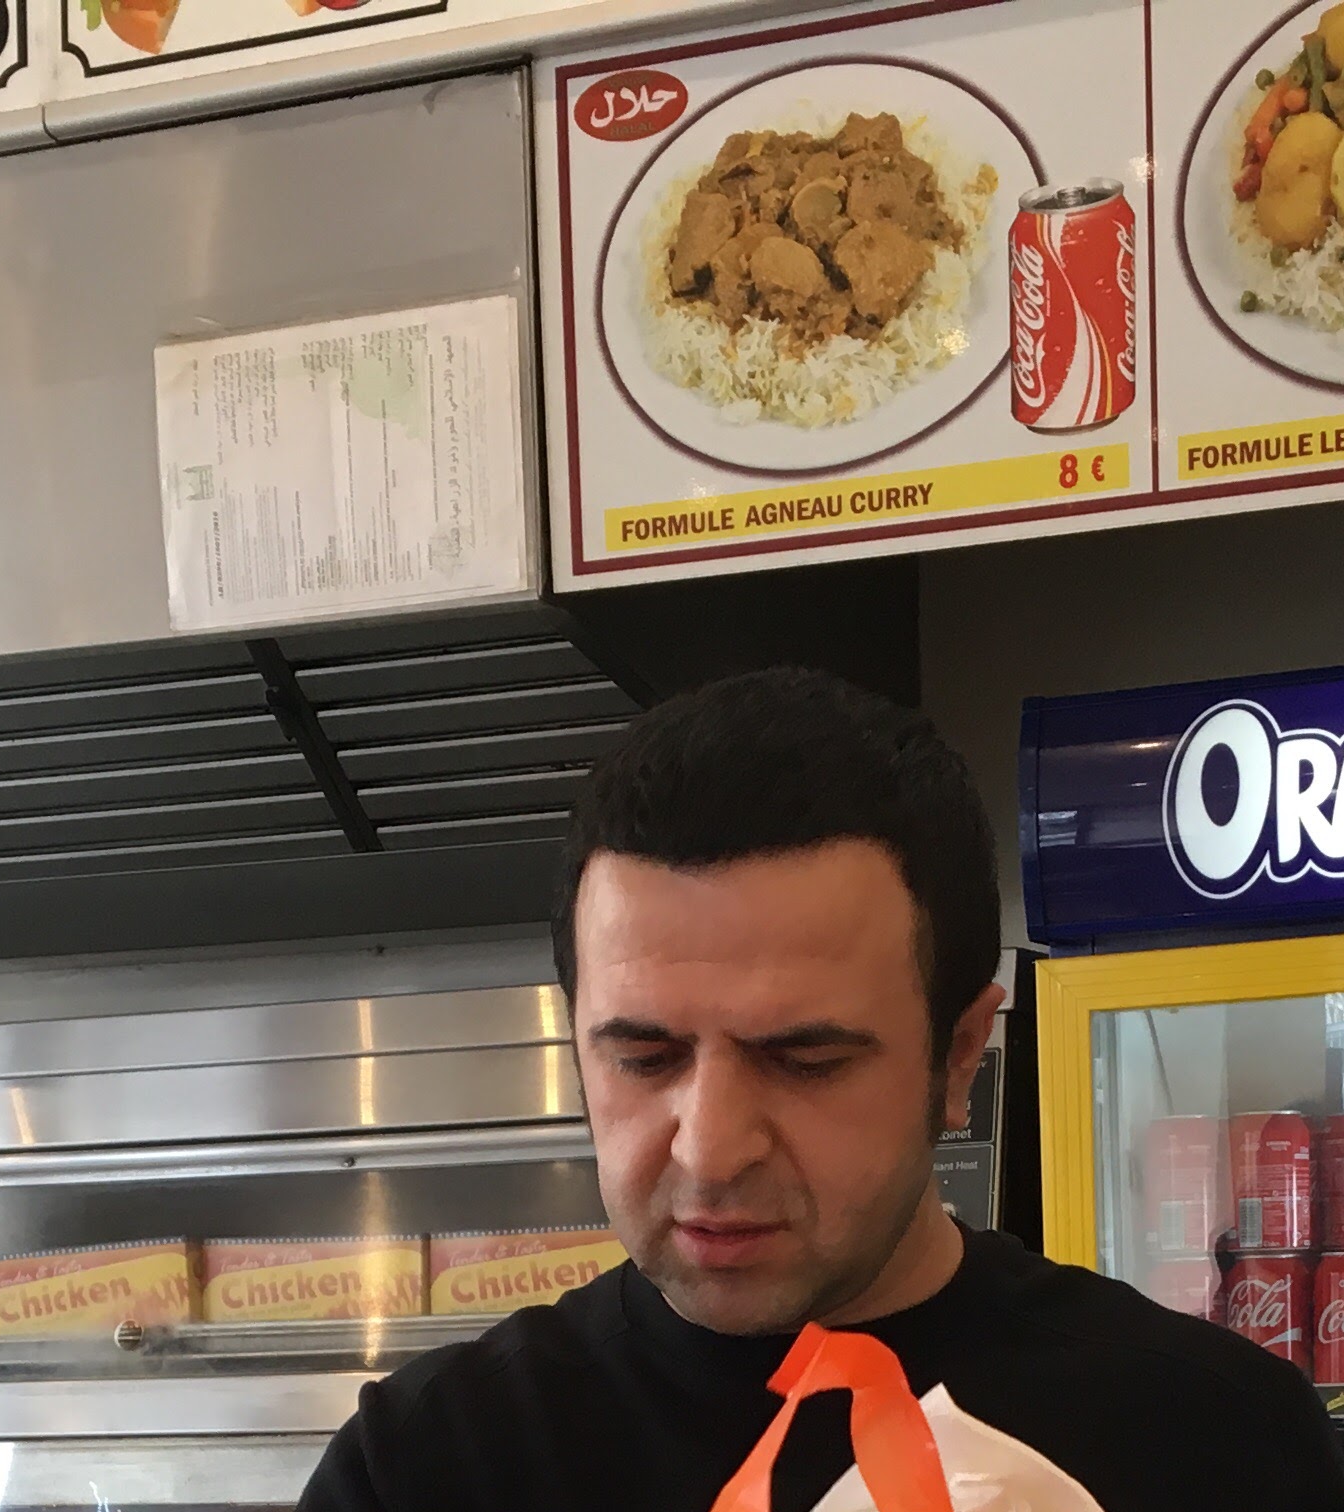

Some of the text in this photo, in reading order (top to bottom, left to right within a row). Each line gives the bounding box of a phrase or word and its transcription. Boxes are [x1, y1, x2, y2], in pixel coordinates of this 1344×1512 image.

[589, 84, 678, 128] حلال
[1010, 236, 1047, 409] Coca-Cola
[1058, 452, 1106, 490] 8 €
[1186, 429, 1315, 472] FORMULE
[620, 482, 935, 543] FORMULE AGNEAU CURRY
[221, 1269, 363, 1309] Chicken
[450, 1259, 601, 1304] Chicken
